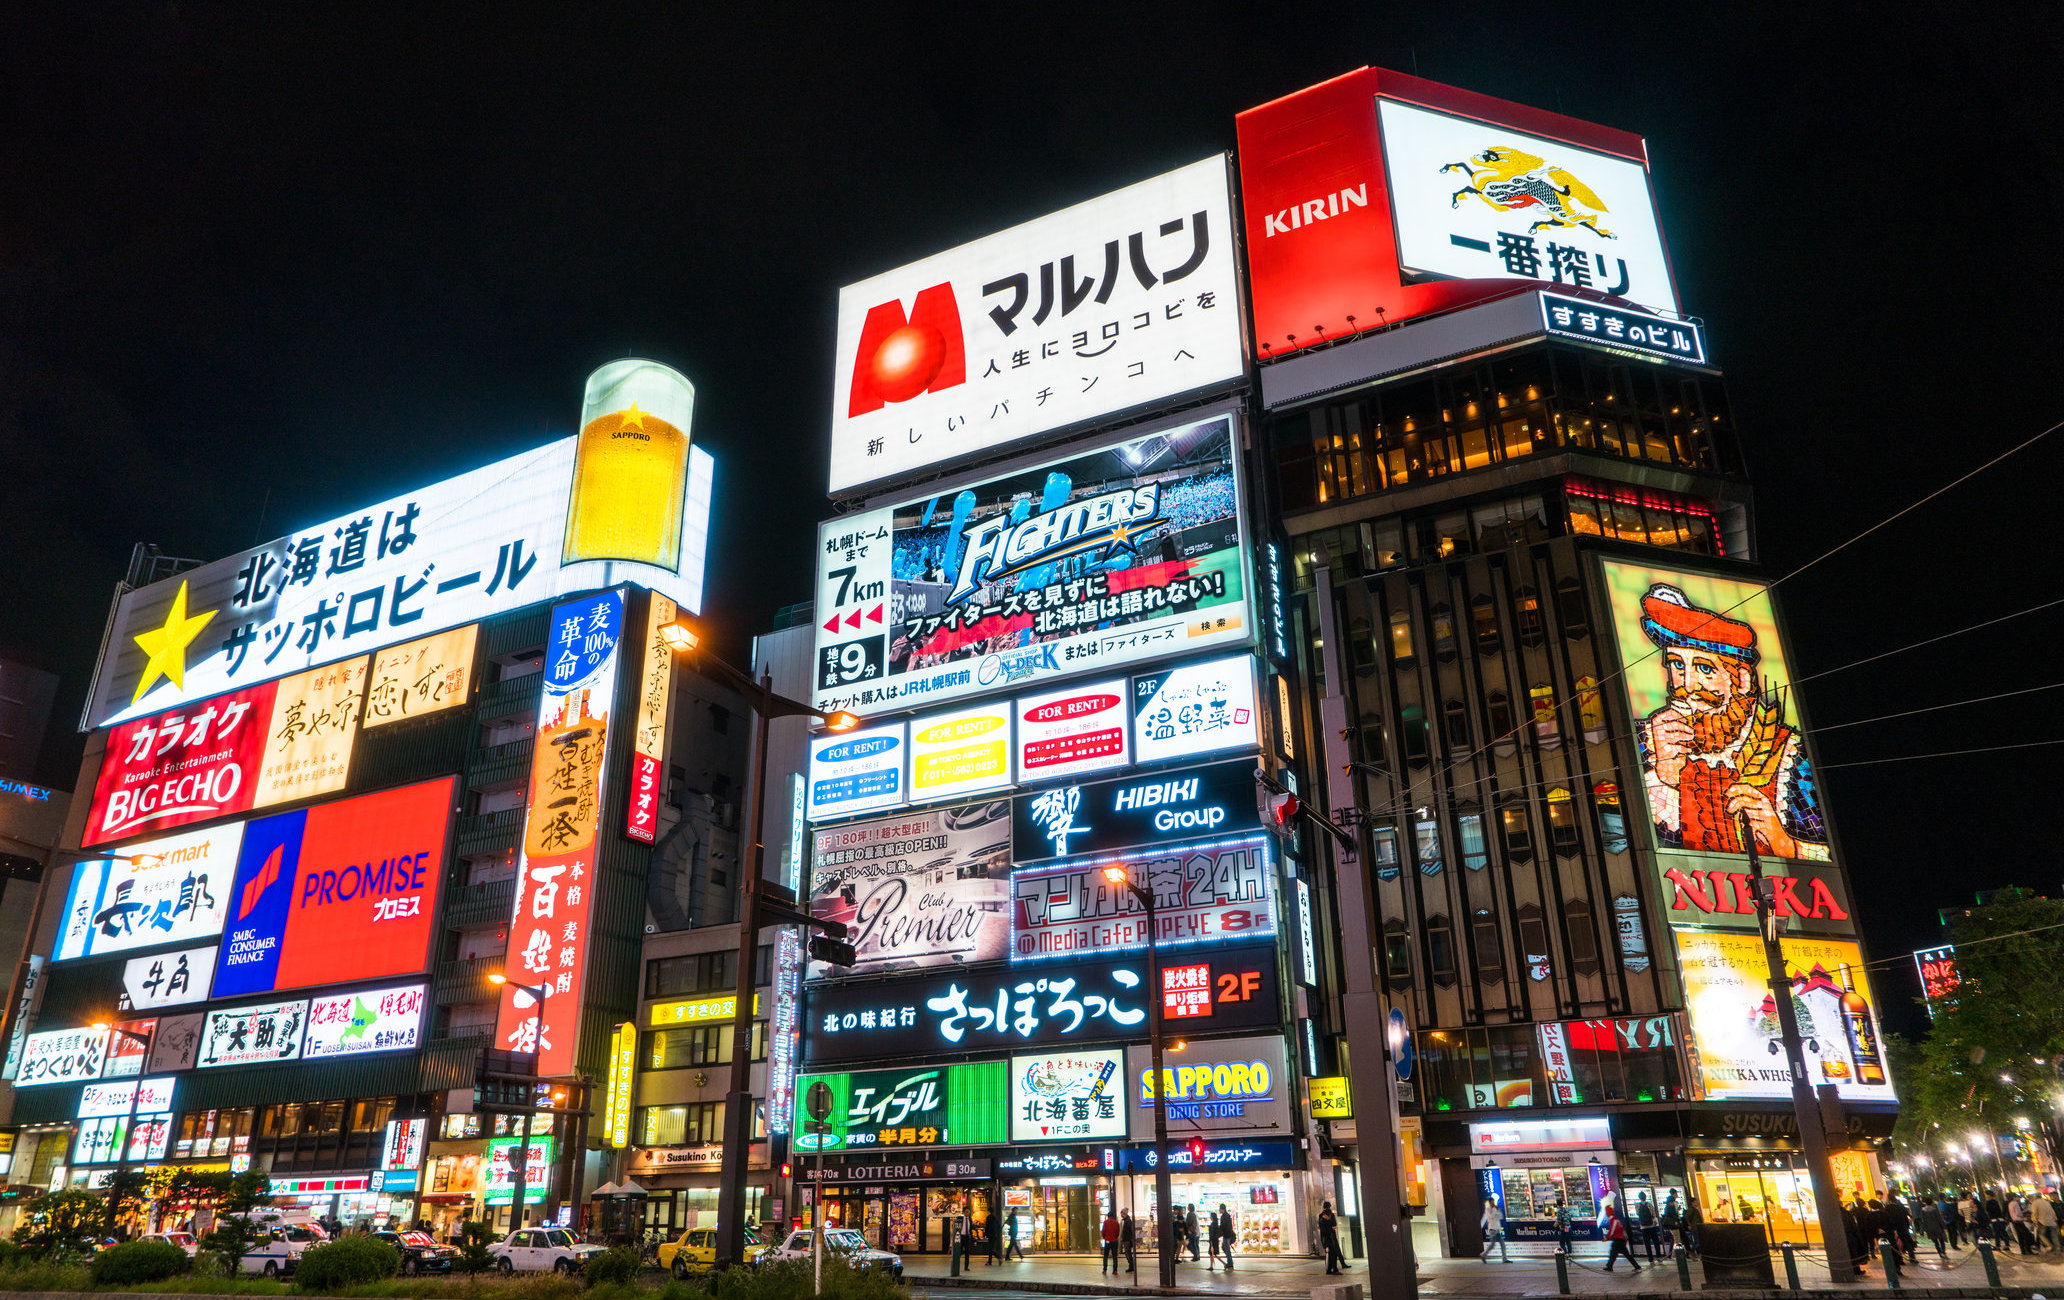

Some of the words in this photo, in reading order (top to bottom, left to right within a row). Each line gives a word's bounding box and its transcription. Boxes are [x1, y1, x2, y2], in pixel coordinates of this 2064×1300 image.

[1264, 183, 1367, 238] KIRIN
[982, 210, 1210, 337] マルハン
[1450, 230, 1630, 296] 一番搾り
[983, 292, 1216, 378] 人生にヨロコビを
[1552, 306, 1690, 351] すすきのビル
[867, 349, 1194, 457] 新しいパチンコへ
[611, 431, 651, 442] SAPPORO
[234, 502, 420, 607] 北海道は
[826, 526, 889, 553] 札幌ドーム
[846, 546, 868, 561] まで
[947, 482, 1159, 605] FIGHTERS
[828, 566, 884, 608] 7km
[222, 539, 537, 677] サッポロビール
[906, 575, 1107, 639] ファイターズを見ずに
[554, 616, 584, 681] 革命
[1002, 652, 1023, 661] OFFICIAL
[1024, 648, 1038, 657] SHOP
[1065, 641, 1099, 661] または
[1106, 629, 1175, 652] ファイターズ
[825, 648, 838, 686] 地下鉄
[899, 670, 970, 696] JR札幌駅前
[1138, 679, 1157, 696] 2F
[1037, 705, 1062, 720] FOR
[1145, 697, 1231, 741] 温野菜
[125, 700, 250, 764] カラオケ
[929, 727, 952, 741] FOR
[124, 766, 161, 784] Karaoke
[164, 749, 233, 777] Entertainment
[828, 746, 850, 760] FOR
[102, 786, 165, 833] BIG
[162, 763, 241, 810] ECHO
[636, 758, 655, 825] カラオケ
[1115, 778, 1199, 811] HIBIKI
[1031, 786, 1092, 857] 響
[1154, 806, 1225, 831] Group
[817, 836, 832, 851] 9F
[301, 851, 429, 909] PROMISE
[566, 861, 585, 906] 本格
[1187, 848, 1265, 909] 24H
[1664, 867, 1848, 920] NIKKA
[93, 870, 214, 938] 長次郎
[373, 895, 421, 923] プロミス
[919, 892, 946, 911] Club
[229, 936, 276, 955] CONSUMER
[232, 928, 256, 943] SMBC
[1038, 930, 1088, 953] Media
[1092, 925, 1132, 947] Cafe
[227, 949, 264, 966] FINANCE
[508, 864, 566, 1054] 百姓一揆
[556, 921, 578, 994] 麦焼酎
[142, 953, 190, 999] 牛角
[1164, 966, 1208, 989] 炭火焼き
[1217, 971, 1261, 1003] 2F
[310, 998, 351, 1025] 北海道
[675, 1002, 735, 1019] すすきの交
[823, 1006, 917, 1032] 北の味紀行
[927, 969, 1145, 1042] さっぽろっこ
[306, 1036, 322, 1056] 1F
[1142, 1062, 1270, 1099] SAPPORO
[1710, 1069, 1756, 1081] NIKKA
[84, 1087, 97, 1102] 2F
[615, 1050, 632, 1144] すすきの交番
[1023, 1095, 1115, 1121] 北海番屋
[1169, 1104, 1200, 1120] DRUG
[1204, 1103, 1245, 1118] STORE
[878, 1127, 938, 1145] 半月分
[1051, 1124, 1091, 1135] 1Fこの奥
[667, 1151, 706, 1163] Susukino
[848, 1164, 920, 1179] LOTTERIA
[1023, 1155, 1073, 1170] さっぽろっこ
